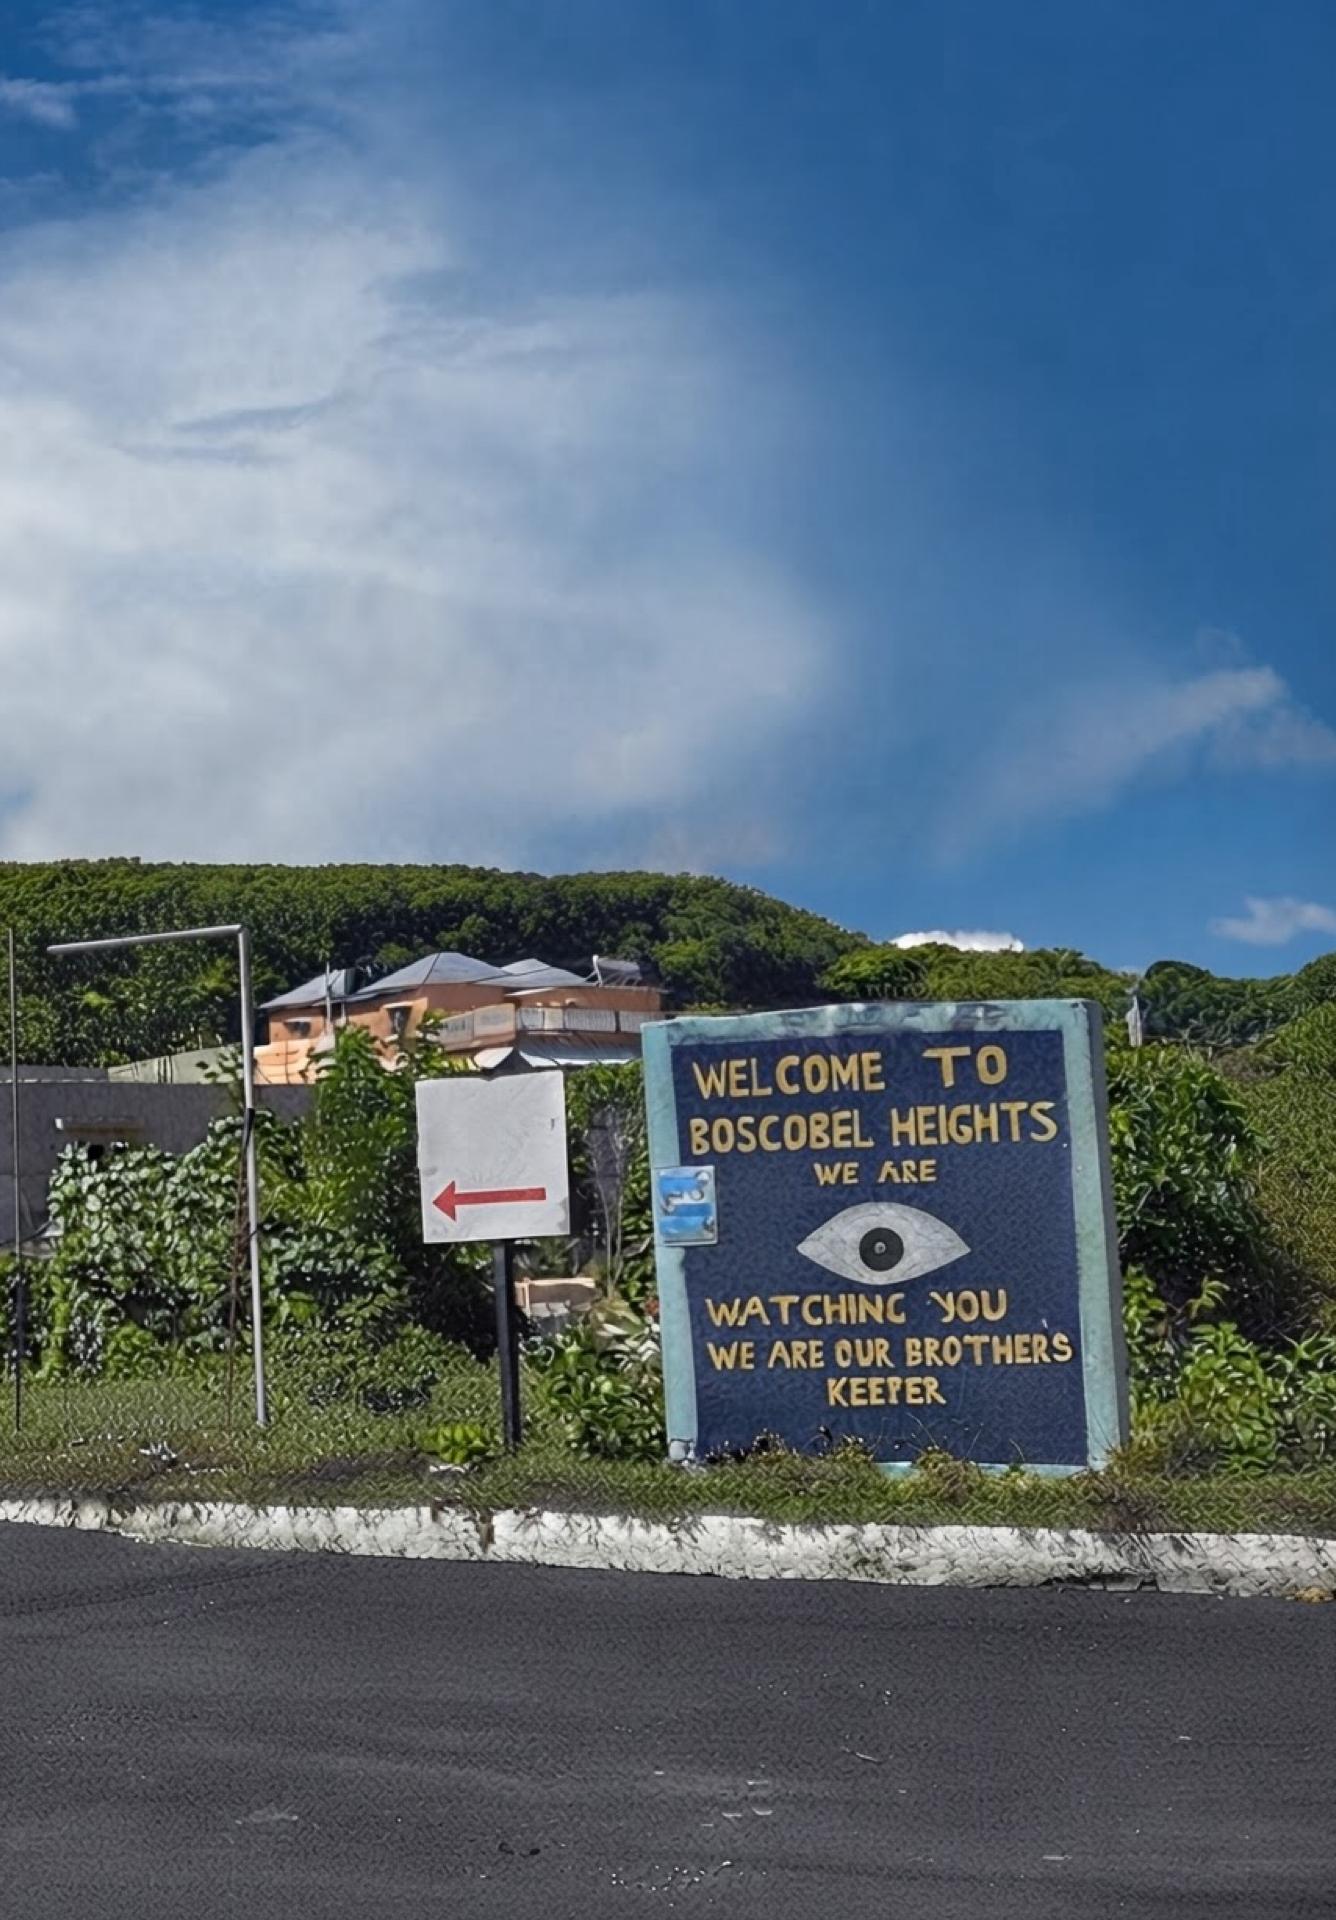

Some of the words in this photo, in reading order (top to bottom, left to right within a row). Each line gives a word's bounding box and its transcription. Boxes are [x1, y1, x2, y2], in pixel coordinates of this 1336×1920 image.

[693, 1051, 885, 1098] WELCOME
[922, 1045, 1008, 1088] TO
[689, 1110, 874, 1155] BOSCOBEL
[890, 1101, 1058, 1147] HEIGHTS
[813, 1161, 860, 1186] WE
[877, 1158, 937, 1184] ARE
[929, 1289, 1008, 1323] YOU
[706, 1341, 755, 1370] WE
[767, 1339, 825, 1369] ARE
[834, 1337, 895, 1368] OUR
[905, 1333, 1074, 1367] BROTHERS
[826, 1375, 947, 1408] KEEPER
